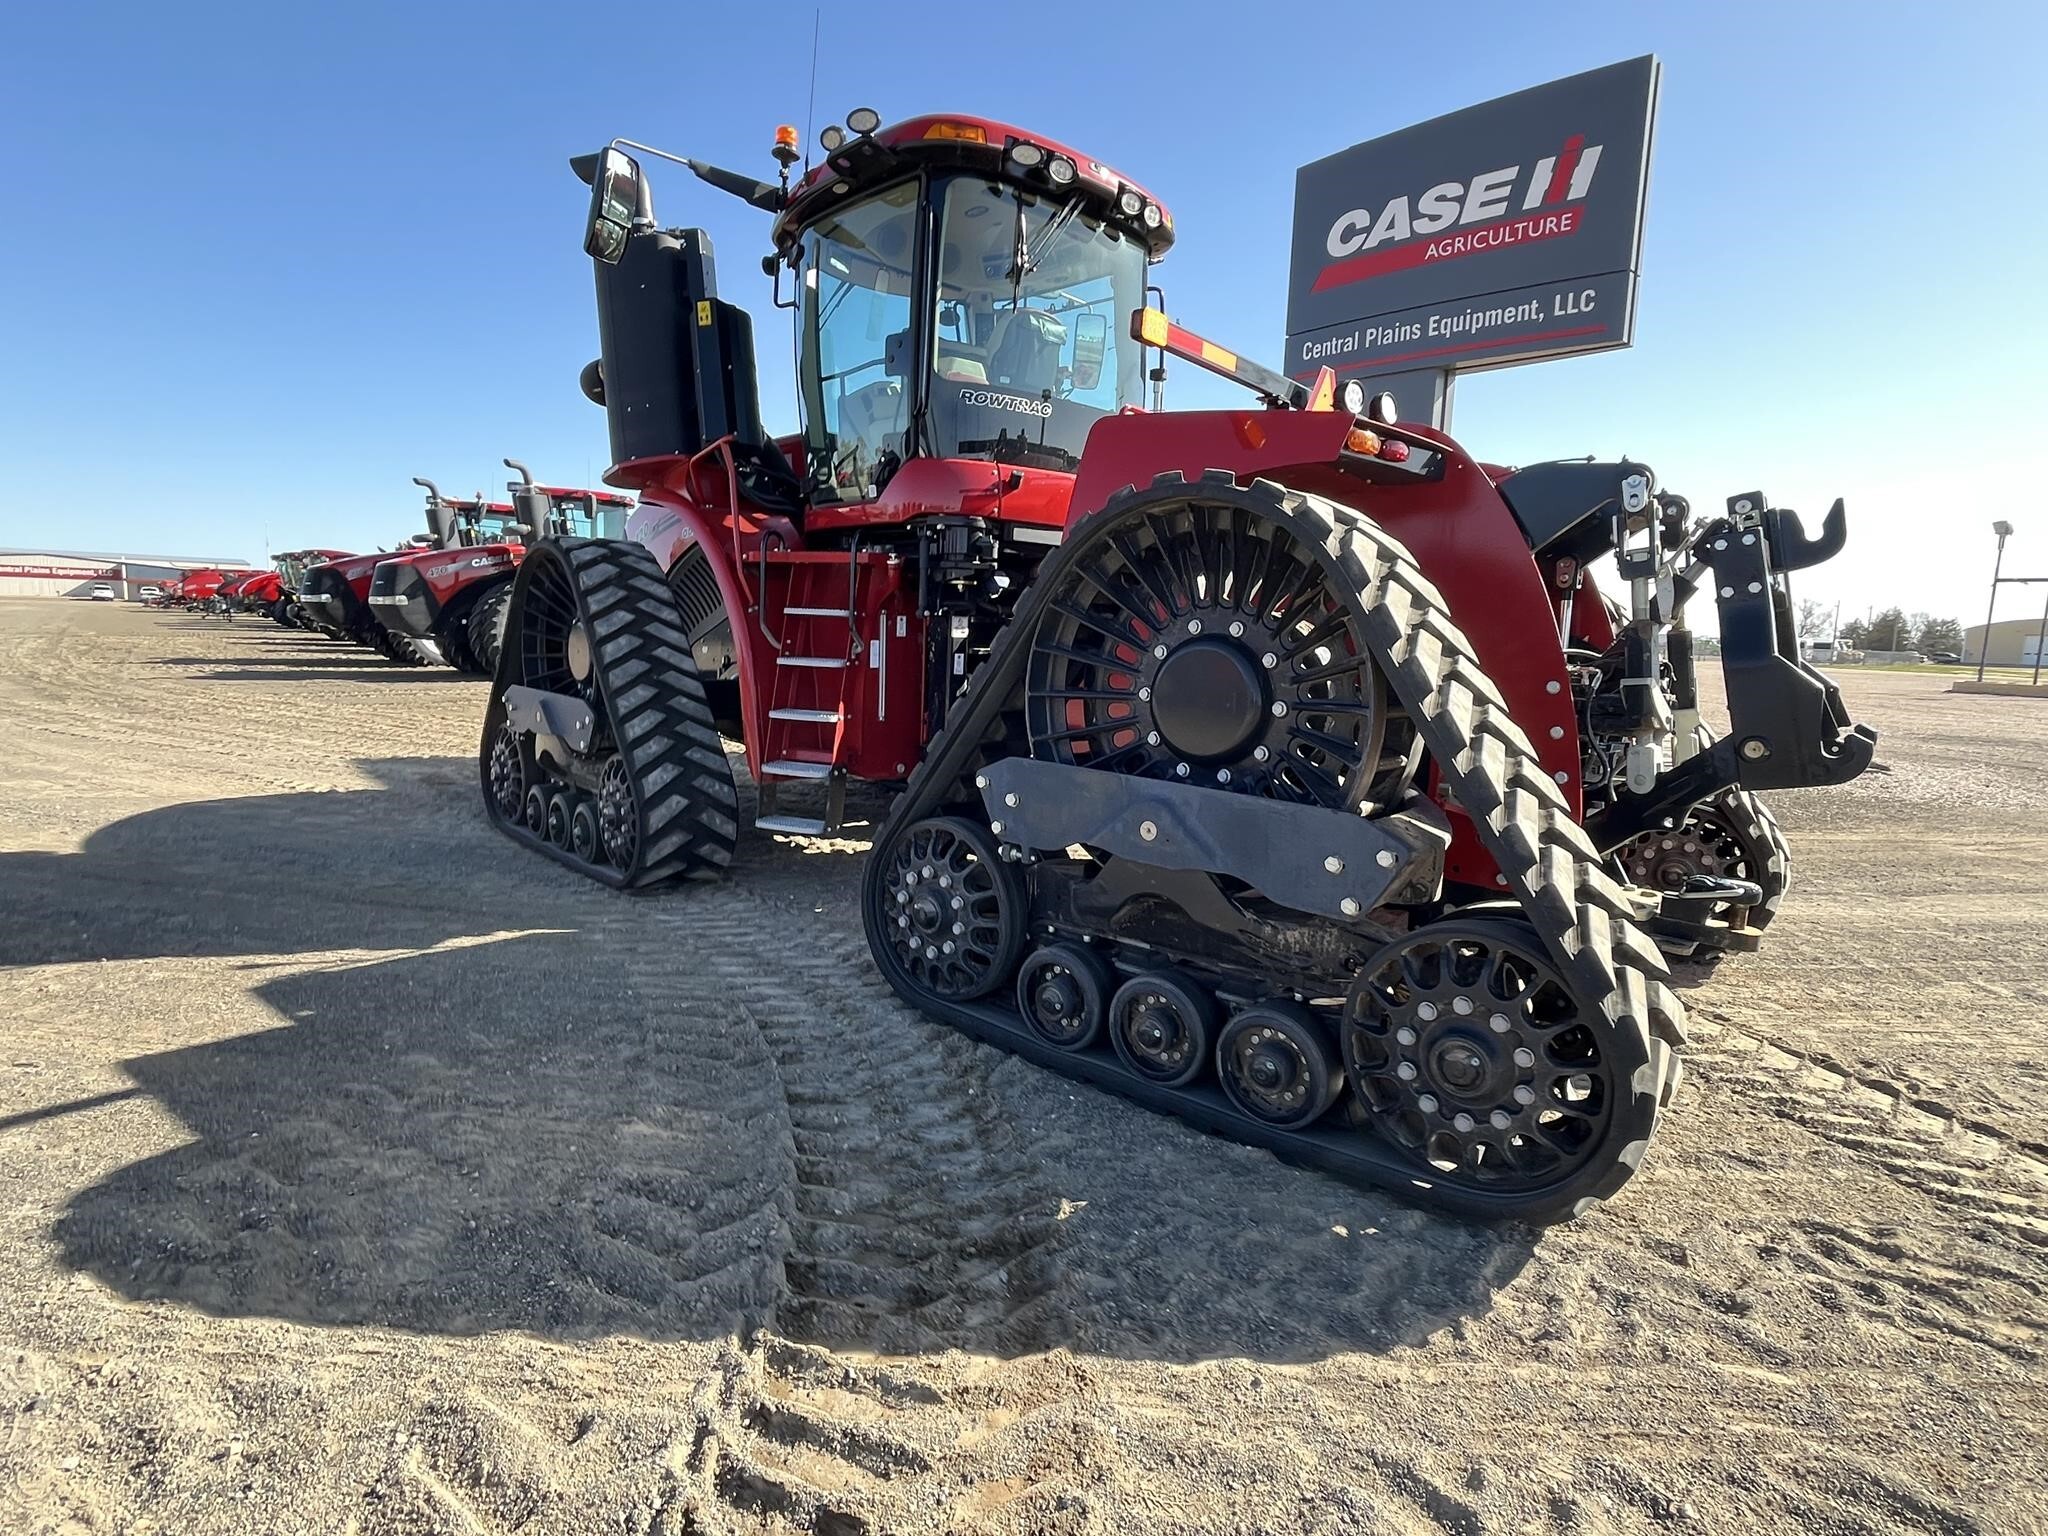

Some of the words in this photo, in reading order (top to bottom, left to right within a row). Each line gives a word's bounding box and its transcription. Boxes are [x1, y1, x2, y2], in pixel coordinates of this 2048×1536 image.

[1326, 164, 1520, 258] CASE
[1522, 133, 1604, 211] IH
[1423, 212, 1573, 260] AGRICULTURE
[1302, 331, 1359, 361] Central
[1365, 320, 1422, 348] Plains
[1428, 299, 1545, 337] Equipment,
[1553, 288, 1597, 317] LLC
[959, 388, 1053, 418] ROWTRAC
[99, 569, 113, 577] LLC
